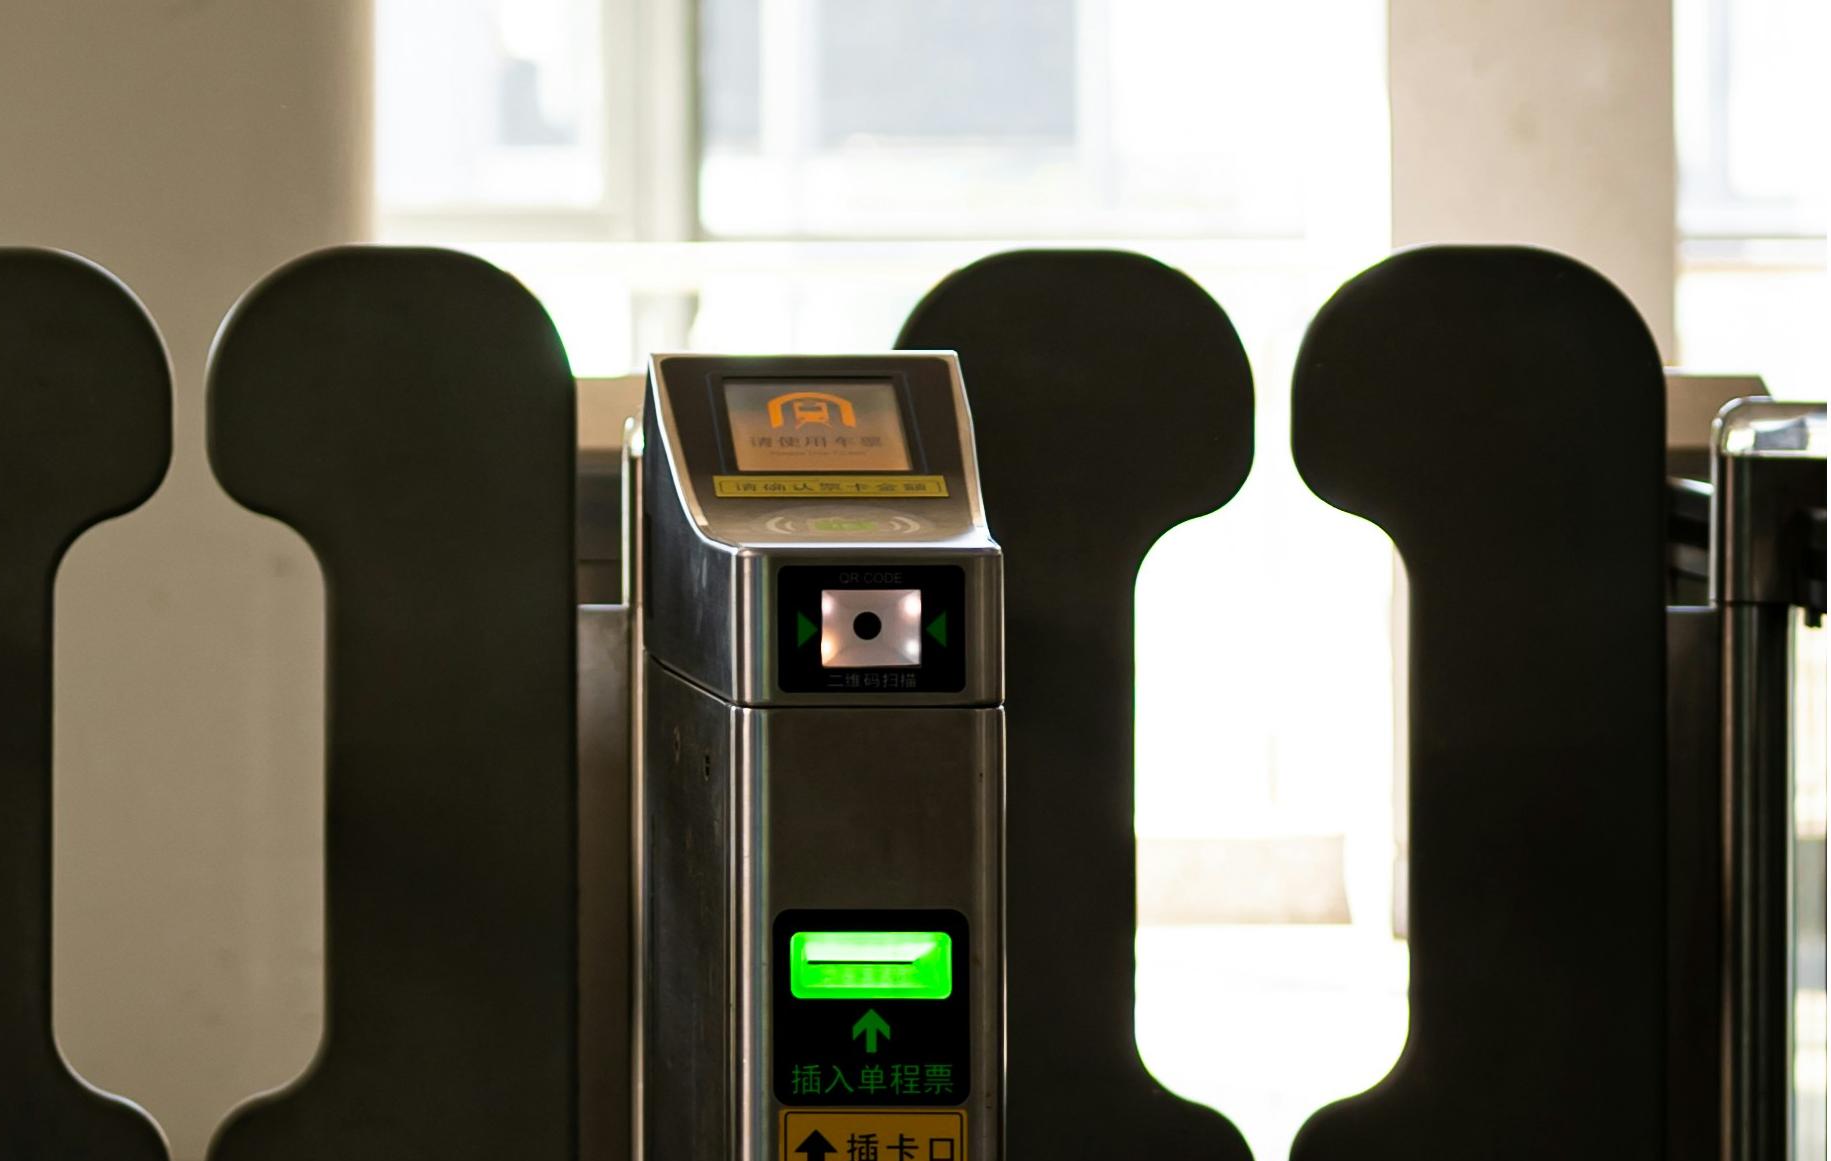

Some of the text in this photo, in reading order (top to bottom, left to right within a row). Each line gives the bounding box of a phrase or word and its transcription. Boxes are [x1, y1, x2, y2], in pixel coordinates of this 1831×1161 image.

[839, 571, 903, 584] QR CODE
[827, 672, 917, 688] 二维码扫描
[791, 1064, 955, 1096] 插入单程票
